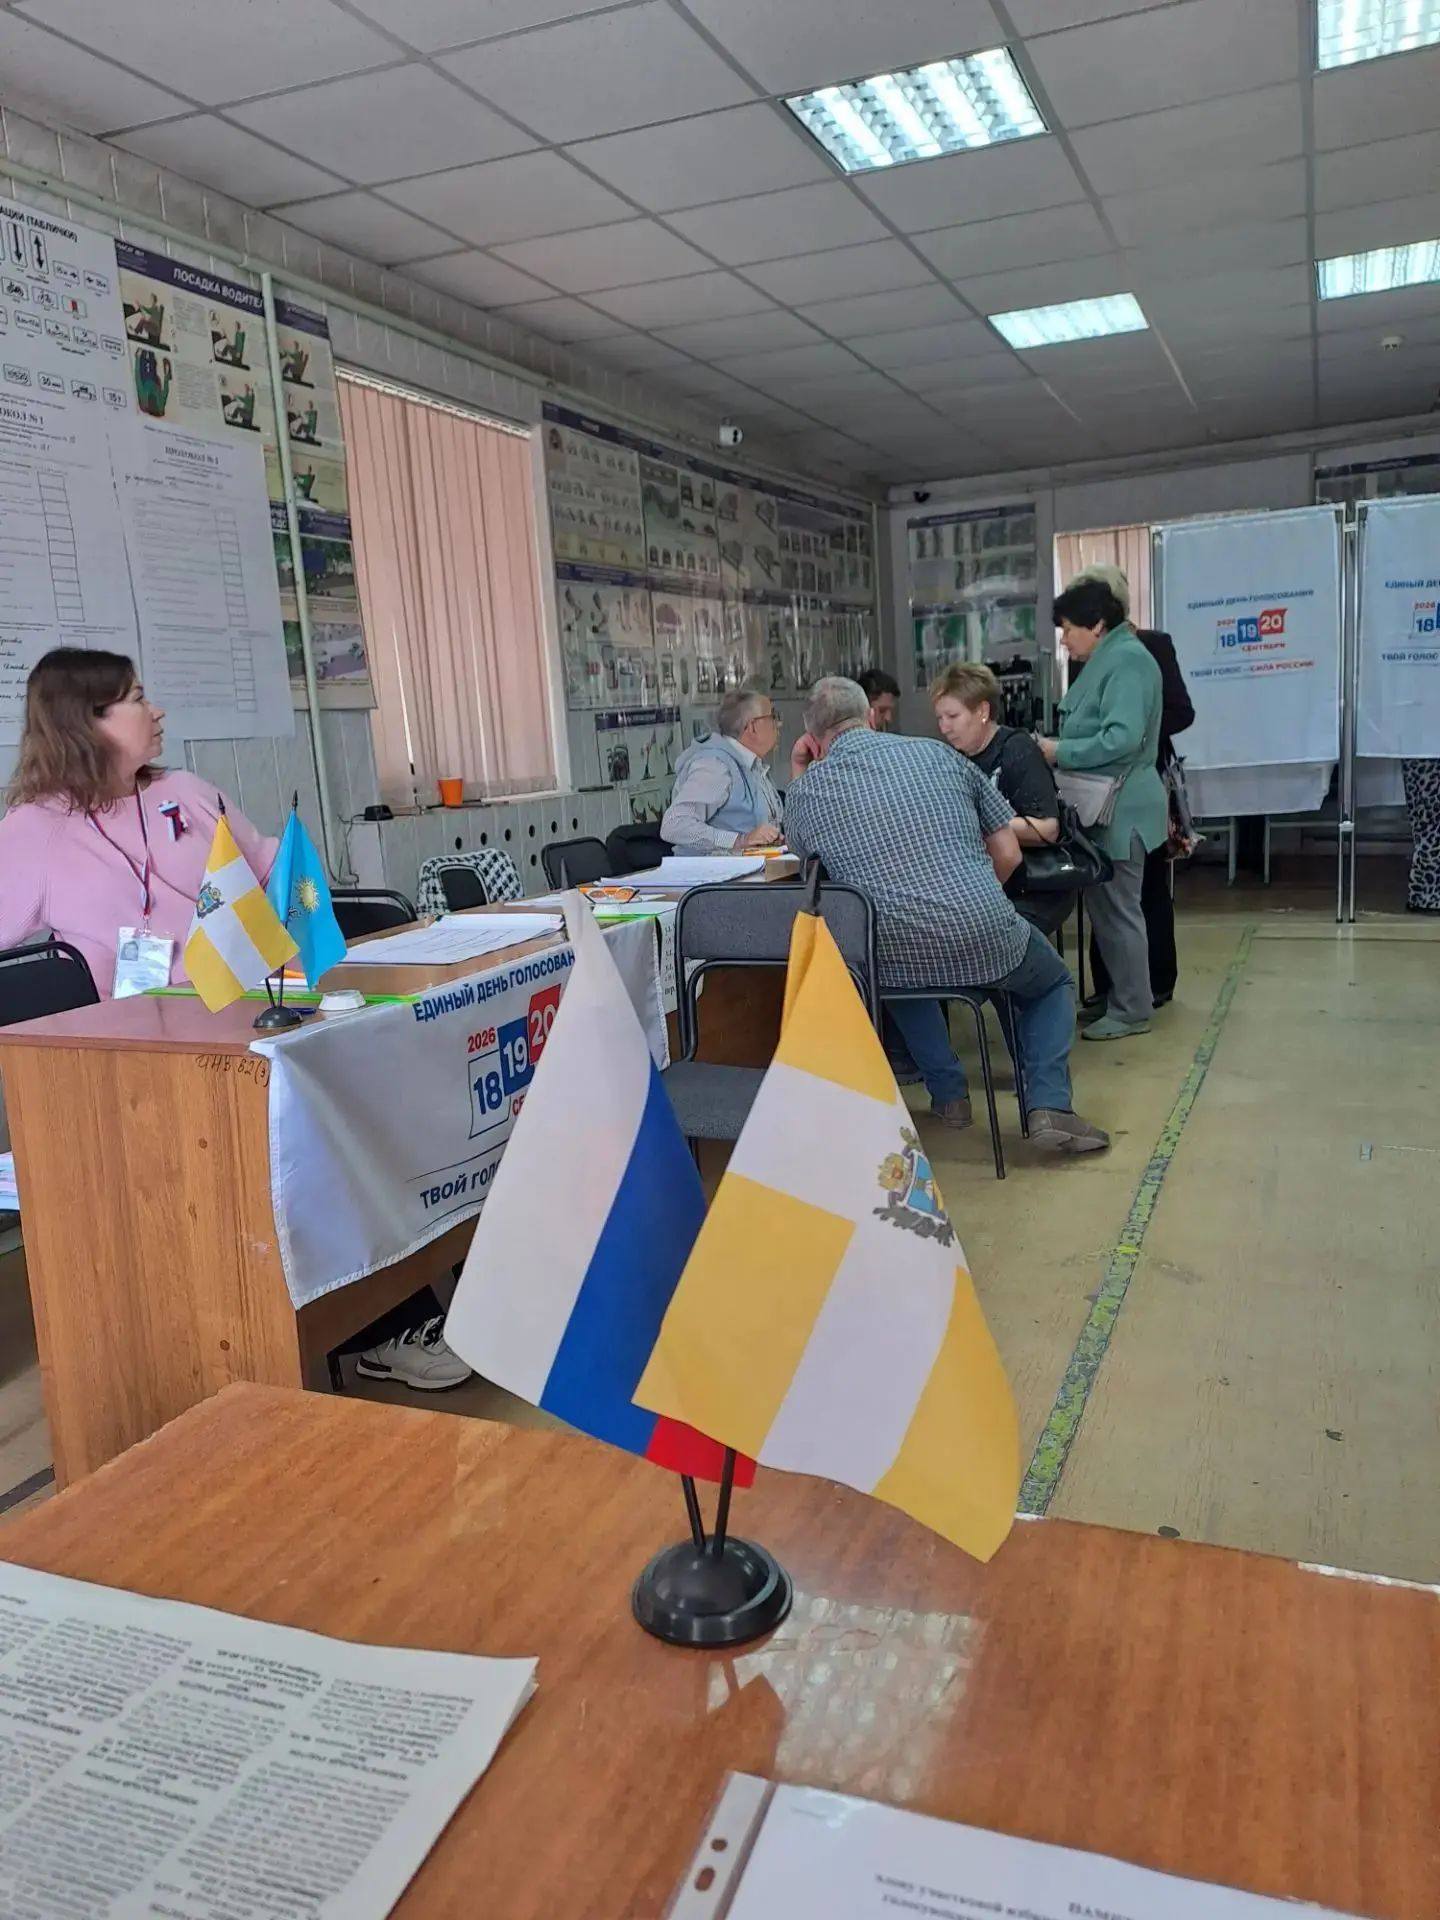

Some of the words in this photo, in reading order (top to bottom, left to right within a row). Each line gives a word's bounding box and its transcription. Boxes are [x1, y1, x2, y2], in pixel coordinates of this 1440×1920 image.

[173, 267, 221, 295] ПОСАДКА
[1384, 579, 1424, 589] ЕДИНЫЙ
[1188, 597, 1224, 610] ЕДИНЫЙ
[1220, 633, 1236, 648] 18
[1240, 623, 1257, 639] 19
[1260, 614, 1282, 631] 20
[1416, 618, 1434, 632] 18
[1213, 664, 1241, 676] ГОЛОС
[1250, 661, 1274, 672] СИЛА
[1408, 652, 1438, 660] ГОЛОС
[412, 983, 475, 1022] ЕДИНЫЙ
[477, 975, 509, 1004] ДЕНЬ
[467, 1026, 496, 1053] 2026
[473, 1071, 503, 1115] 18
[503, 1035, 527, 1078] 19
[530, 1003, 558, 1046] 20
[420, 1173, 468, 1209] ТВОЙ
